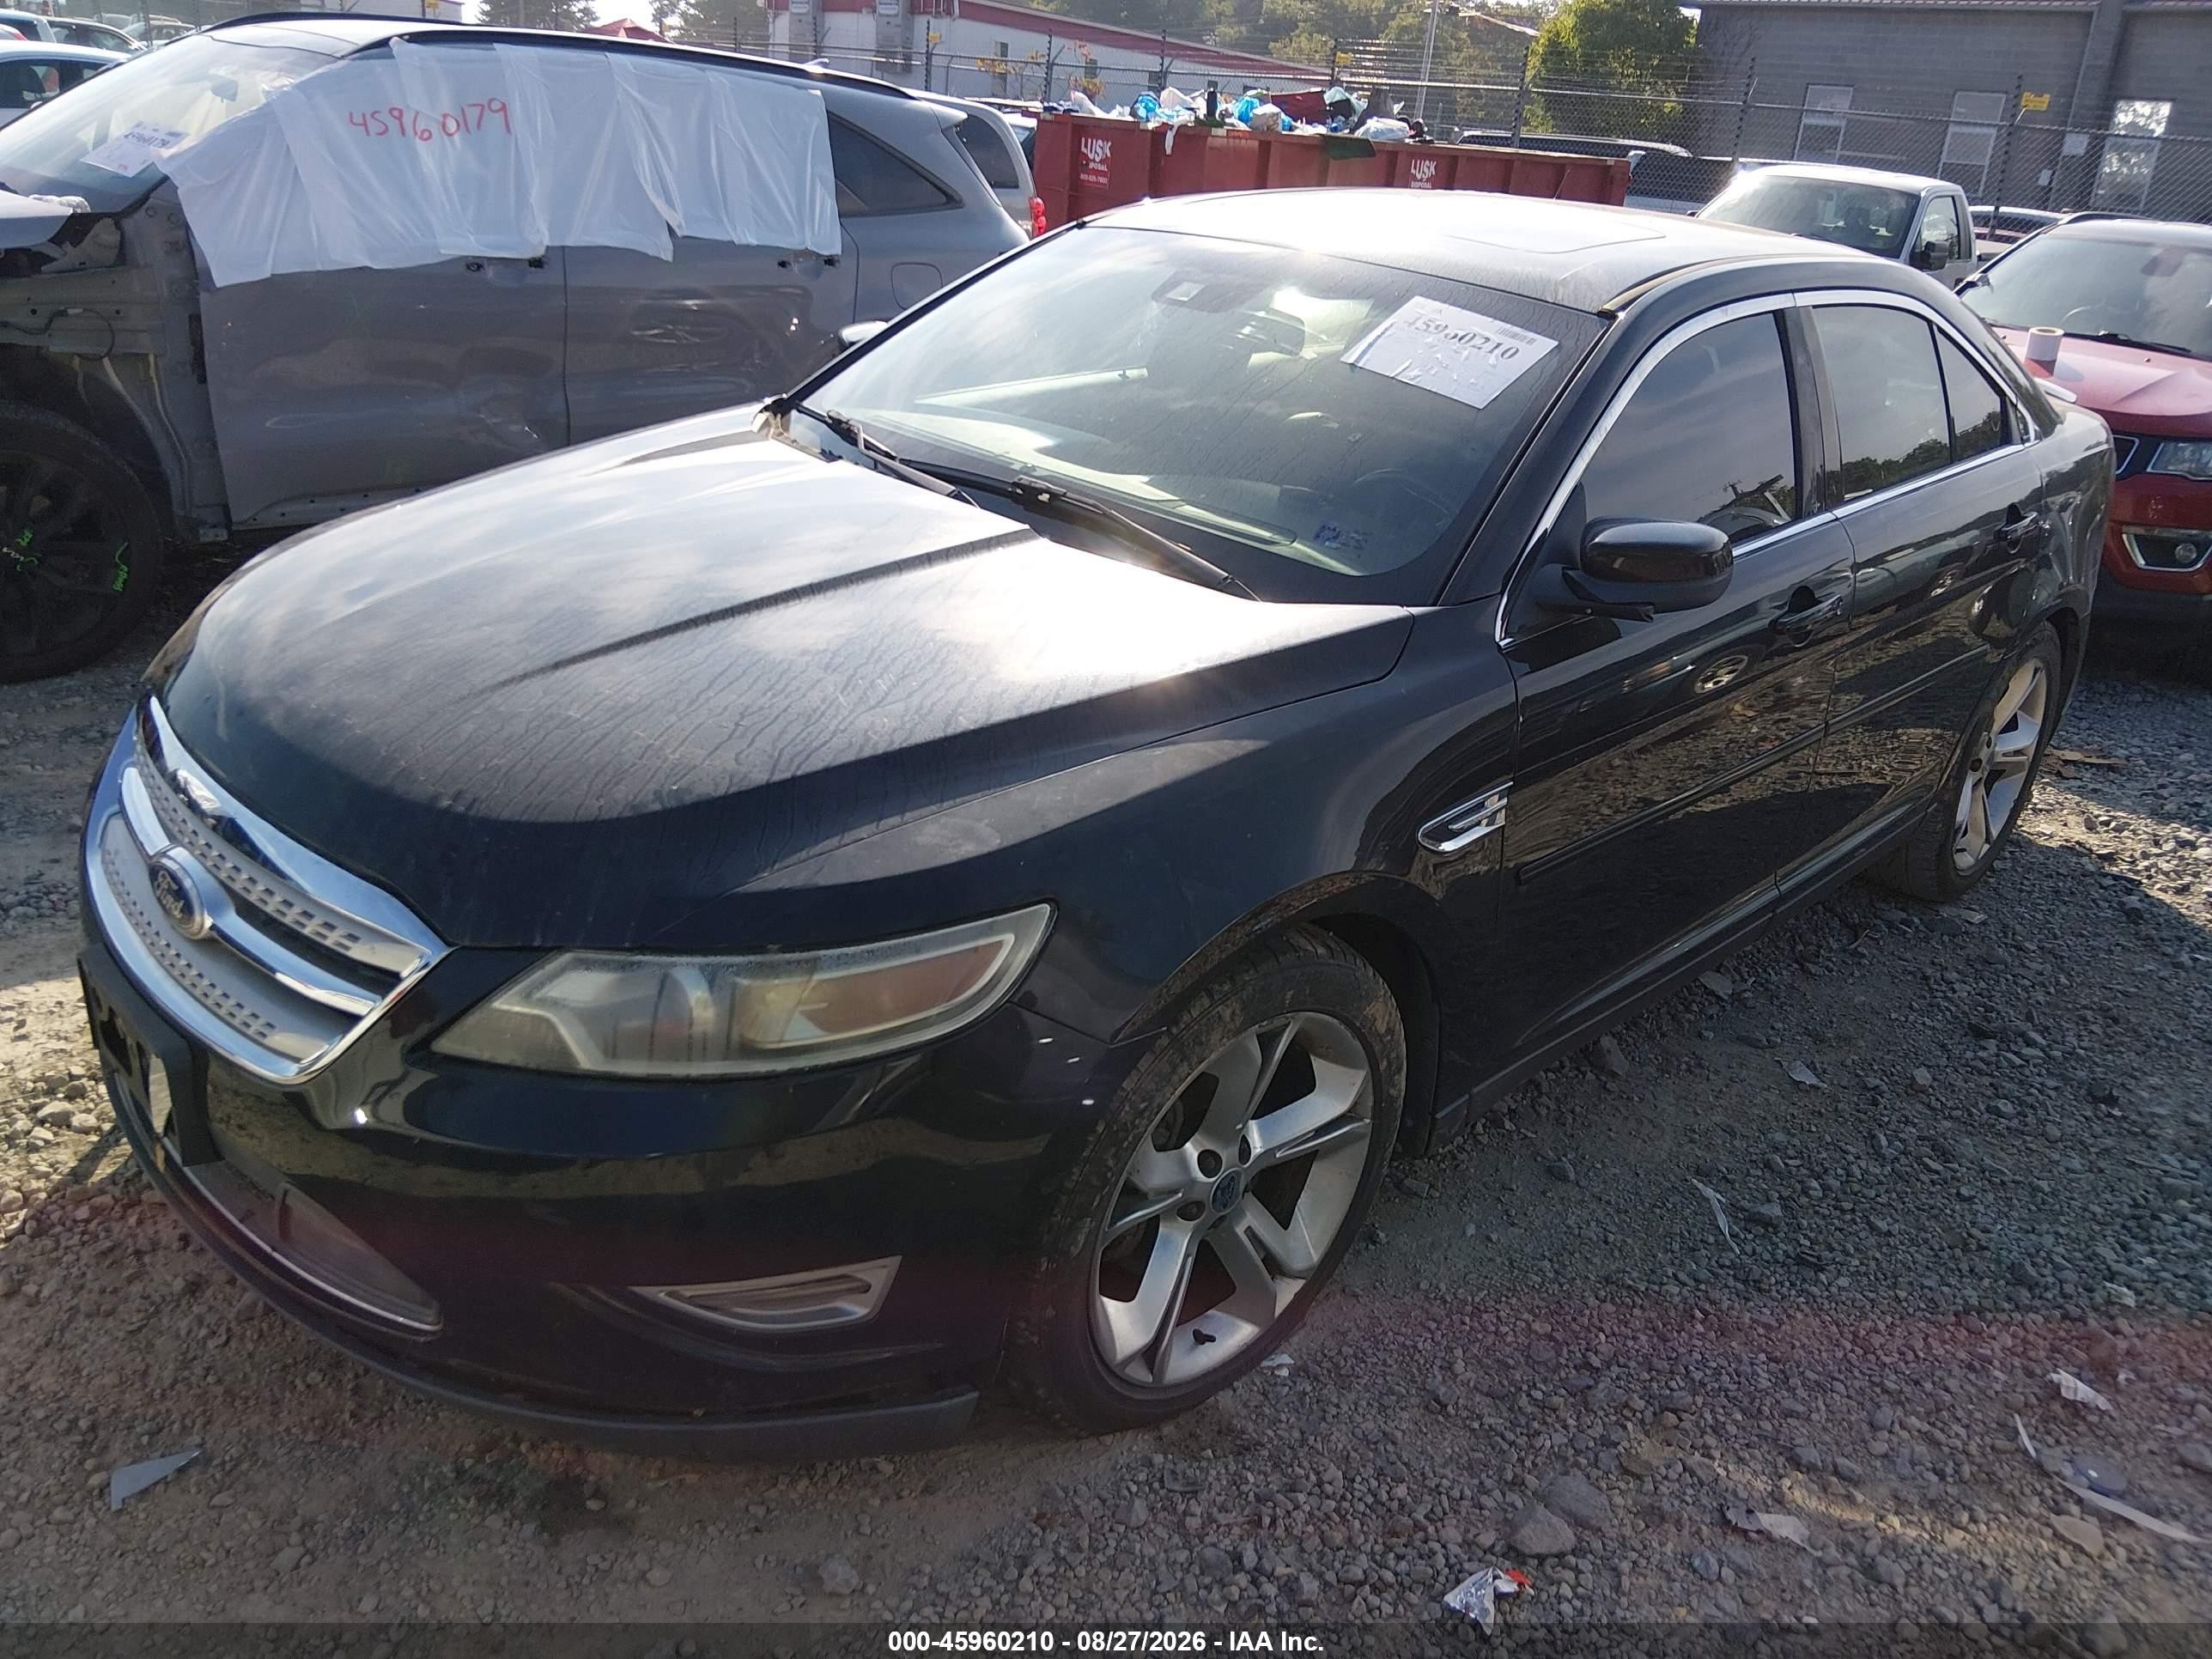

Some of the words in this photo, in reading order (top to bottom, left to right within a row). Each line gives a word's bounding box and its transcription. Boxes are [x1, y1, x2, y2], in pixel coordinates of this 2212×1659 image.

[349, 97, 513, 142] 45960179
[1081, 137, 1111, 162] LUSK
[1411, 159, 1437, 180] LUSK
[155, 870, 185, 919] Ford
